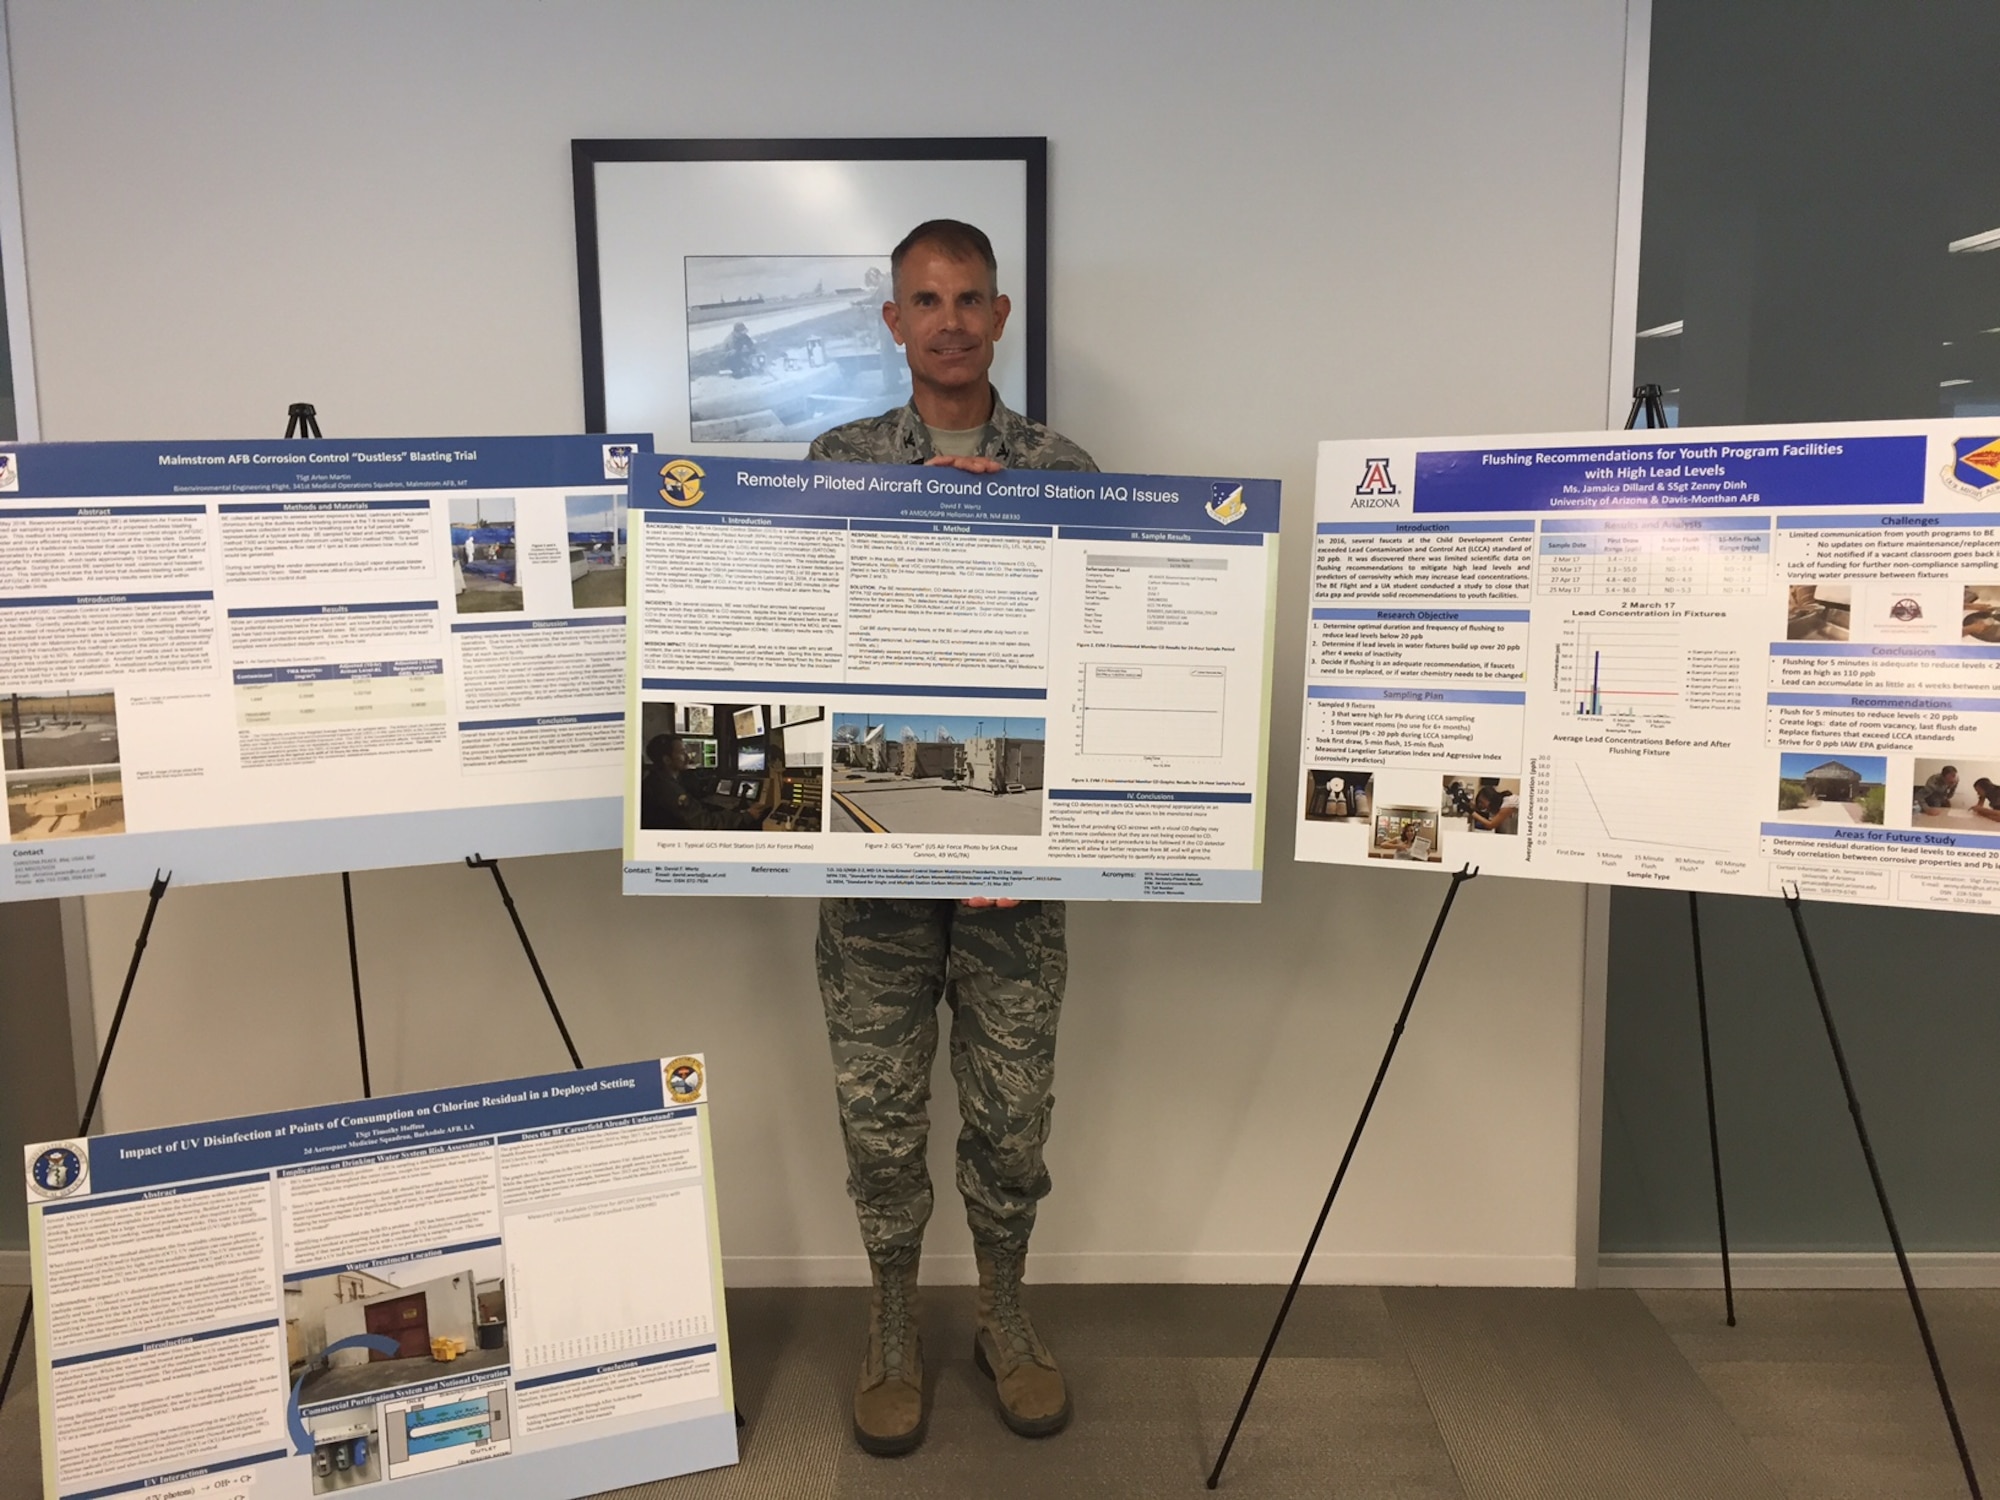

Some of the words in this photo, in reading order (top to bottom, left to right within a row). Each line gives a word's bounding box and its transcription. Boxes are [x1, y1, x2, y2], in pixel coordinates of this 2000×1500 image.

[158, 453, 225, 465] Malmstrom
[227, 453, 250, 464] AFB
[252, 452, 306, 464] Corrosion
[308, 452, 349, 463] Control
[351, 451, 406, 462] “Dustless”
[409, 451, 451, 464] Blasting
[453, 451, 476, 461] Trial
[1482, 452, 1532, 467] Flushing
[1535, 448, 1653, 463] Recommendations
[1656, 448, 1675, 460] for
[1679, 446, 1717, 459] Youth
[1721, 444, 1778, 461] Program
[1782, 443, 1842, 456] Facilities
[1585, 467, 1613, 479] with
[1616, 466, 1646, 481] High
[1649, 465, 1680, 477] Lead
[1684, 465, 1724, 477] Levels
[737, 472, 808, 493] Remotely
[814, 475, 864, 492] Piloted
[868, 477, 922, 494] Aircraft
[926, 479, 981, 496] Ground
[986, 481, 1039, 498] Control
[1044, 483, 1094, 500] Station
[1100, 485, 1127, 502] IAQ
[1132, 486, 1178, 504] Issues
[1563, 484, 1580, 492] Ms.
[1582, 483, 1620, 492] Jamaica
[1622, 482, 1654, 491] Dillard
[1656, 482, 1664, 490] &
[1667, 481, 1688, 492] SSgt
[1690, 480, 1721, 492] Zenny
[1723, 480, 1746, 489] Dinh
[1350, 497, 1400, 509] ARIZONA
[1550, 496, 1595, 508] University
[1597, 496, 1607, 505] of
[1609, 495, 1645, 505] Arizona
[1648, 495, 1656, 504] &
[1659, 493, 1735, 504] Davis-Monthan
[1739, 493, 1759, 502] AFB
[77, 507, 111, 516] Abstract
[283, 503, 316, 511] Methods
[722, 517, 726, 525] I.
[728, 517, 771, 526] Introduction
[1881, 515, 1940, 526] Challenges
[943, 525, 970, 533] Method
[1396, 522, 1450, 532] Introduction
[1141, 533, 1165, 542] Sample
[76, 595, 127, 604] Introduction
[321, 604, 349, 614] Results
[1572, 609, 1596, 617] Lead
[1377, 611, 1415, 619] Research
[1418, 611, 1458, 621] Objective
[532, 620, 568, 628] Discussion
[1872, 646, 1936, 657] Conclusions
[1383, 690, 1422, 701] Sampling
[1424, 690, 1443, 699] Plan
[1851, 696, 1952, 709] Recommendations
[537, 716, 578, 725] Conclusions
[1553, 734, 1583, 745] Average
[1585, 735, 1603, 744] Lead
[1604, 736, 1662, 745] Concentrations
[1665, 738, 1691, 746] Before
[1693, 739, 1708, 747] and
[1710, 739, 1730, 747] After
[1609, 747, 1641, 757] Flushing
[1642, 748, 1670, 756] Fixture
[1126, 792, 1134, 800] IV.
[1135, 792, 1174, 801] Conclusions
[1834, 828, 1864, 839] Areas
[1867, 830, 1882, 840] for
[1886, 831, 1921, 842] Future
[1924, 833, 1955, 846] Study
[13, 848, 44, 858] Contact
[624, 866, 652, 875] Contact:
[751, 866, 790, 874] References:
[1101, 870, 1137, 880] Acronyms:
[1627, 871, 1651, 881] Sample
[1654, 873, 1669, 882] Type
[120, 1143, 161, 1161] Impact
[165, 1141, 178, 1153] of
[180, 1138, 199, 1151] UV
[203, 1128, 271, 1148] Disinfection
[275, 1126, 285, 1138] at
[289, 1121, 324, 1136] Points
[326, 1119, 337, 1131] of
[340, 1109, 413, 1131] Consumption
[416, 1109, 430, 1118] on
[432, 1100, 479, 1116] Chlorine
[482, 1093, 526, 1109] Residual
[529, 1091, 539, 1103] in
[542, 1093, 548, 1101] a
[551, 1083, 597, 1102] Deployed
[600, 1078, 634, 1095] Setting
[142, 1188, 176, 1200] Abstract
[143, 1336, 194, 1352] Introduction
[597, 1360, 638, 1374] Conclusions
[302, 1398, 348, 1415] Commercial
[351, 1390, 394, 1406] Purification
[396, 1385, 421, 1399] System
[423, 1382, 437, 1393] and
[439, 1376, 469, 1390] Notional
[471, 1369, 508, 1385] Operation
[143, 1476, 158, 1488] UV
[159, 1468, 207, 1485] Interactions
